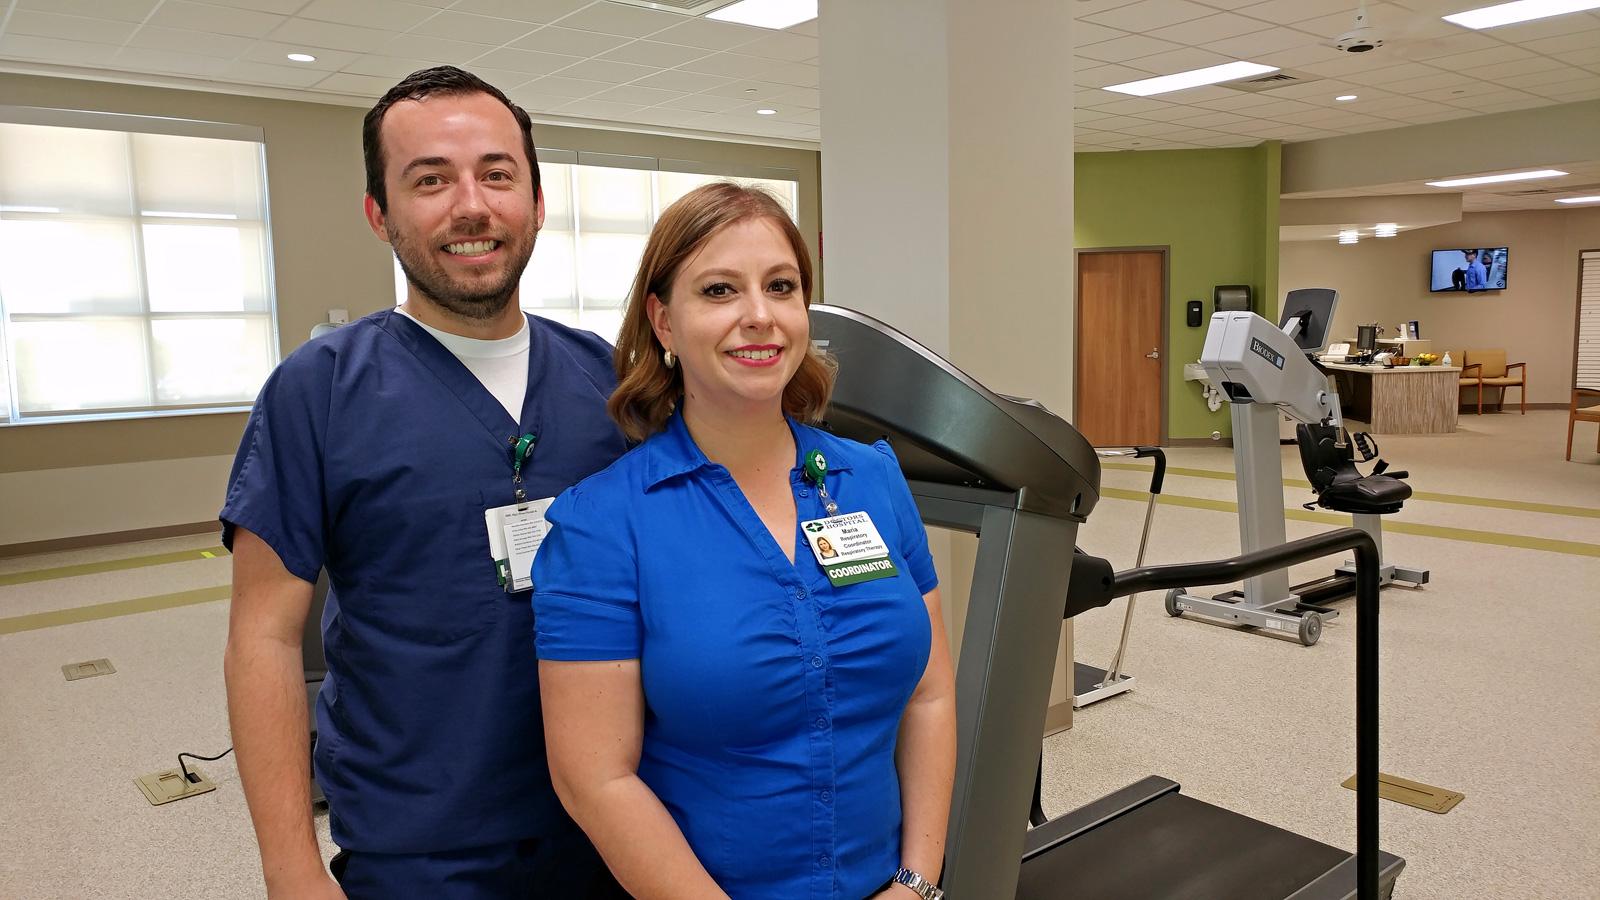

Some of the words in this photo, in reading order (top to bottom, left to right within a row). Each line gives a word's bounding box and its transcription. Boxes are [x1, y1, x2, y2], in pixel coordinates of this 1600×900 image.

[827, 518, 869, 529] HOSPITAL
[840, 533, 868, 541] Respiratory
[843, 539, 872, 549] Coordinator
[841, 548, 866, 556] Respiratory
[829, 560, 893, 578] COORDINATOR
